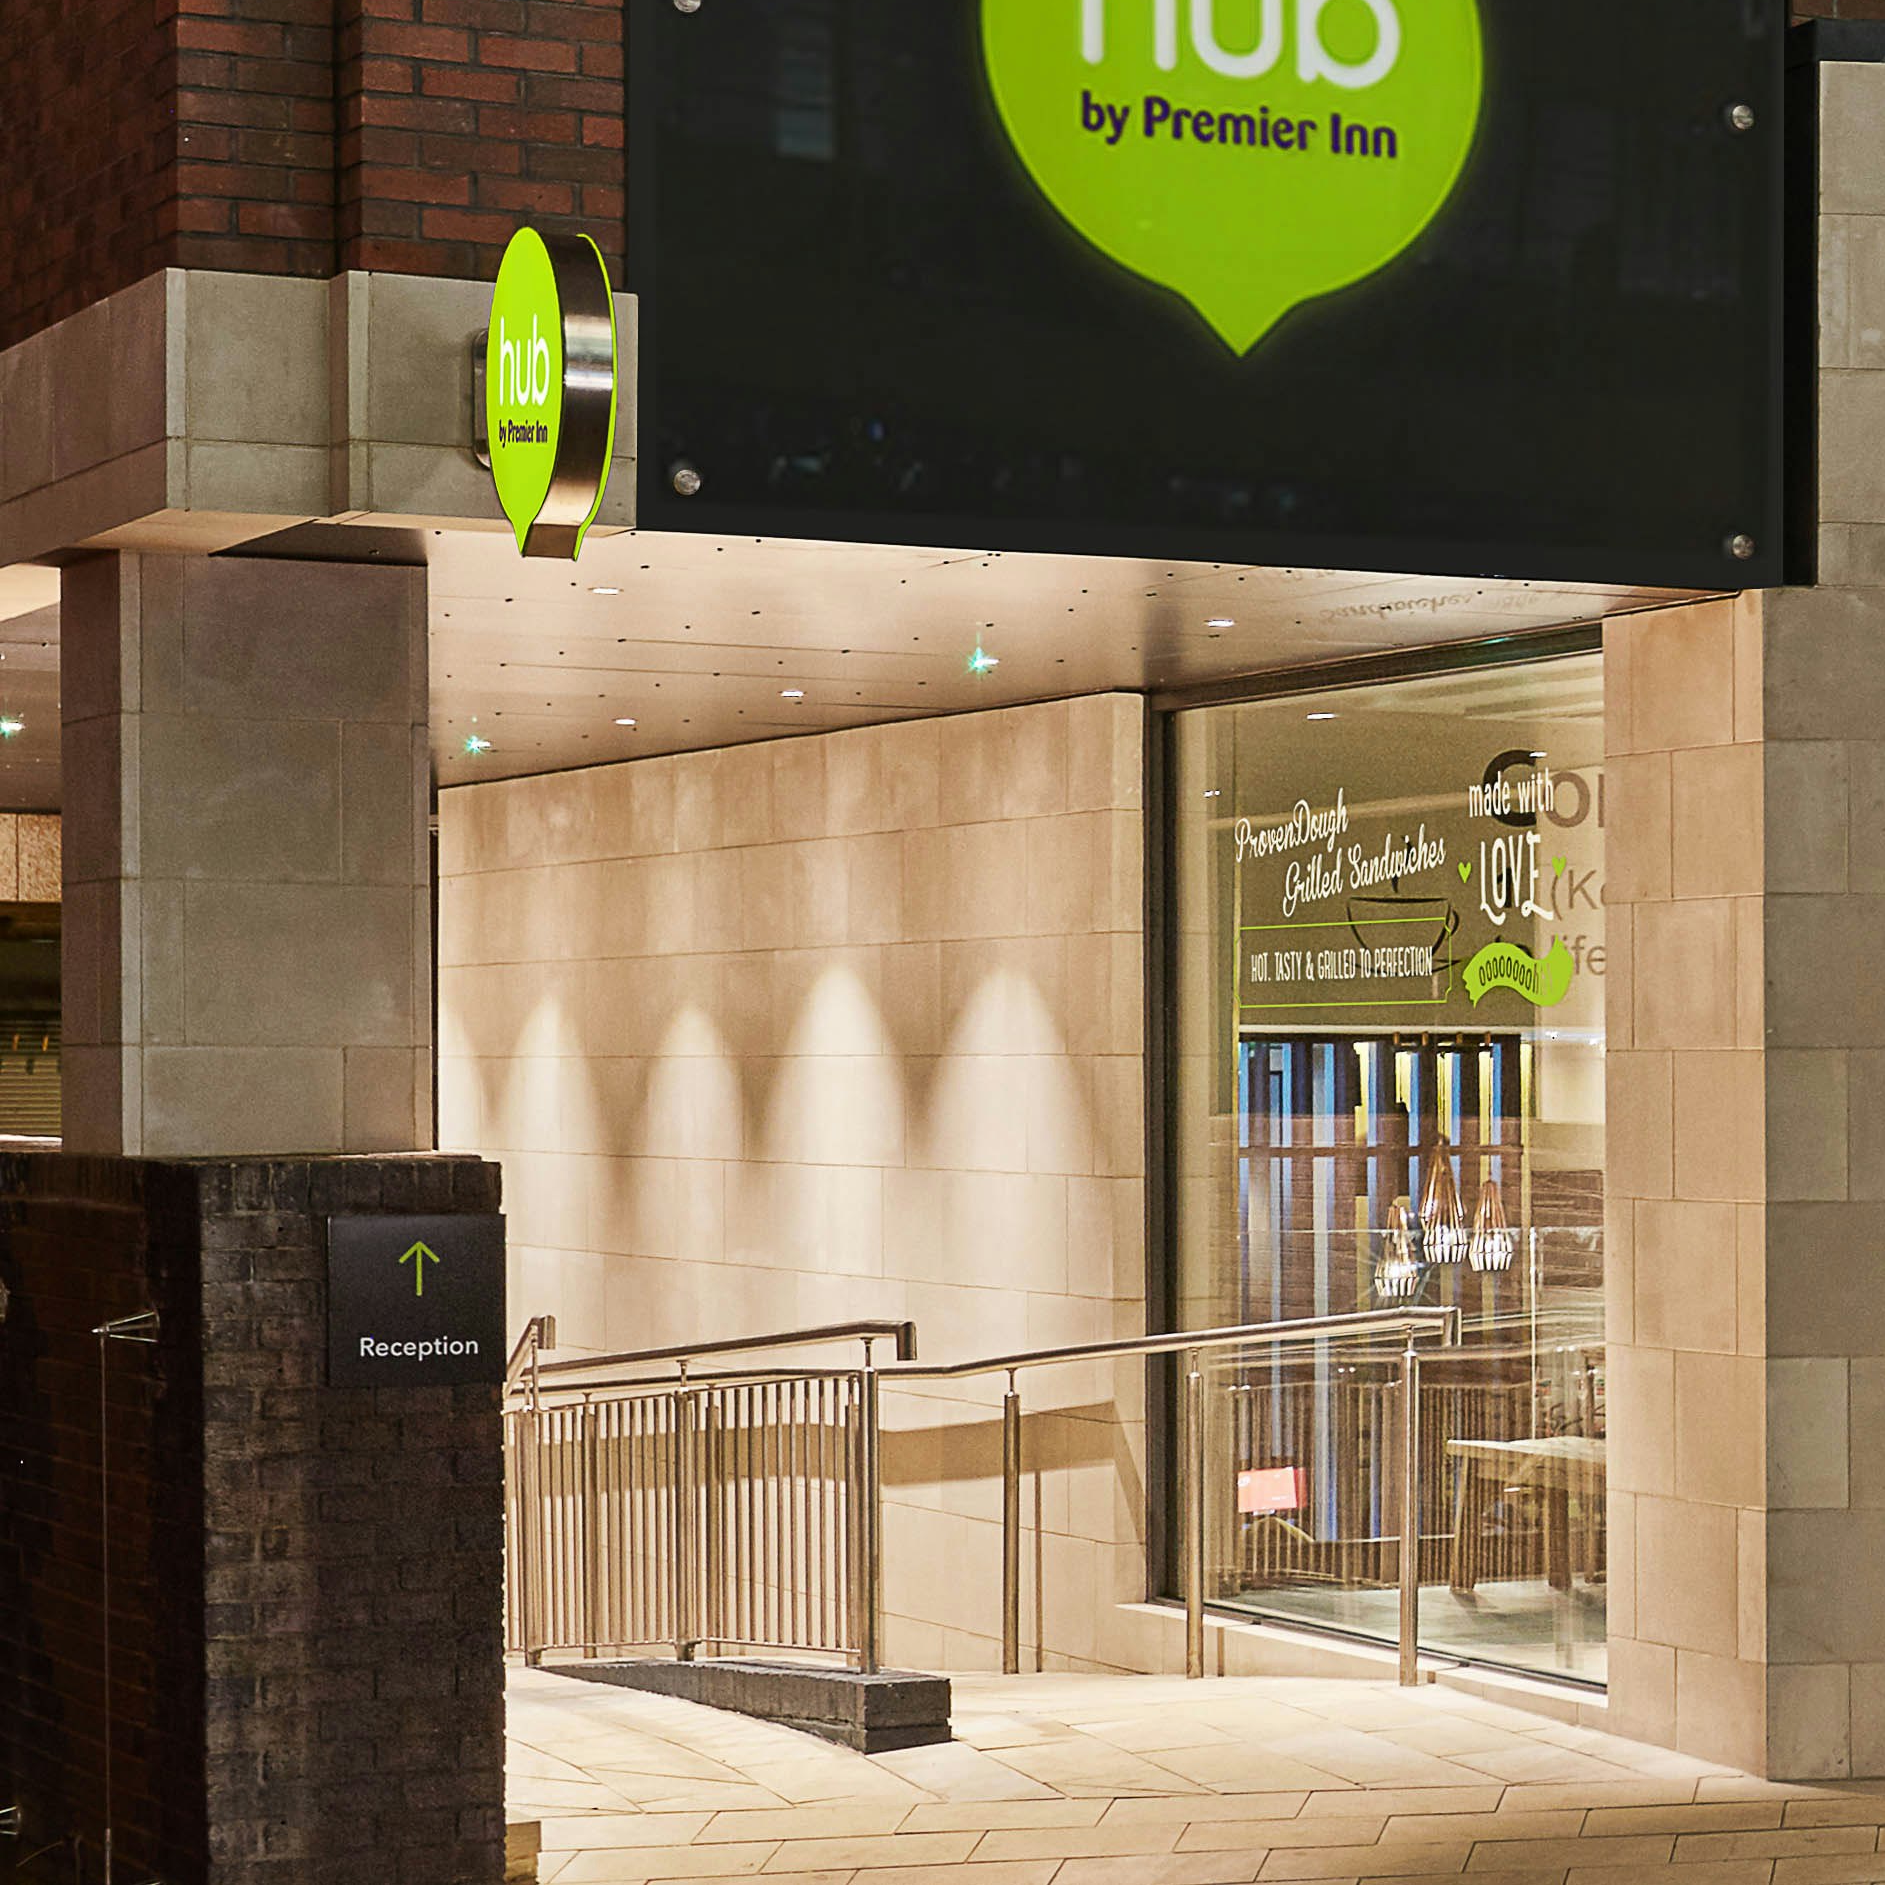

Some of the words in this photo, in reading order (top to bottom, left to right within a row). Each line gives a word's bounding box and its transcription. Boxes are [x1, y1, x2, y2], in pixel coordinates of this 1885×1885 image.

[1080, 90, 1130, 145] by
[1144, 96, 1316, 151] Premier
[1330, 113, 1398, 158] Inn
[499, 313, 550, 406] hub
[499, 420, 506, 448] by
[507, 420, 535, 444] Premier
[536, 420, 548, 444] Inn
[1468, 770, 1511, 818] made
[1517, 767, 1554, 814] with
[1282, 847, 1344, 917] Grilled
[1348, 823, 1447, 889] Sandwiches
[1479, 830, 1554, 926] LOVE
[1274, 951, 1302, 982] TASTY
[1306, 950, 1315, 981] &
[1317, 949, 1356, 980] GRILLED
[1359, 947, 1372, 978] TO
[1374, 946, 1433, 978] PERFECTION
[360, 1335, 479, 1362] Reception
